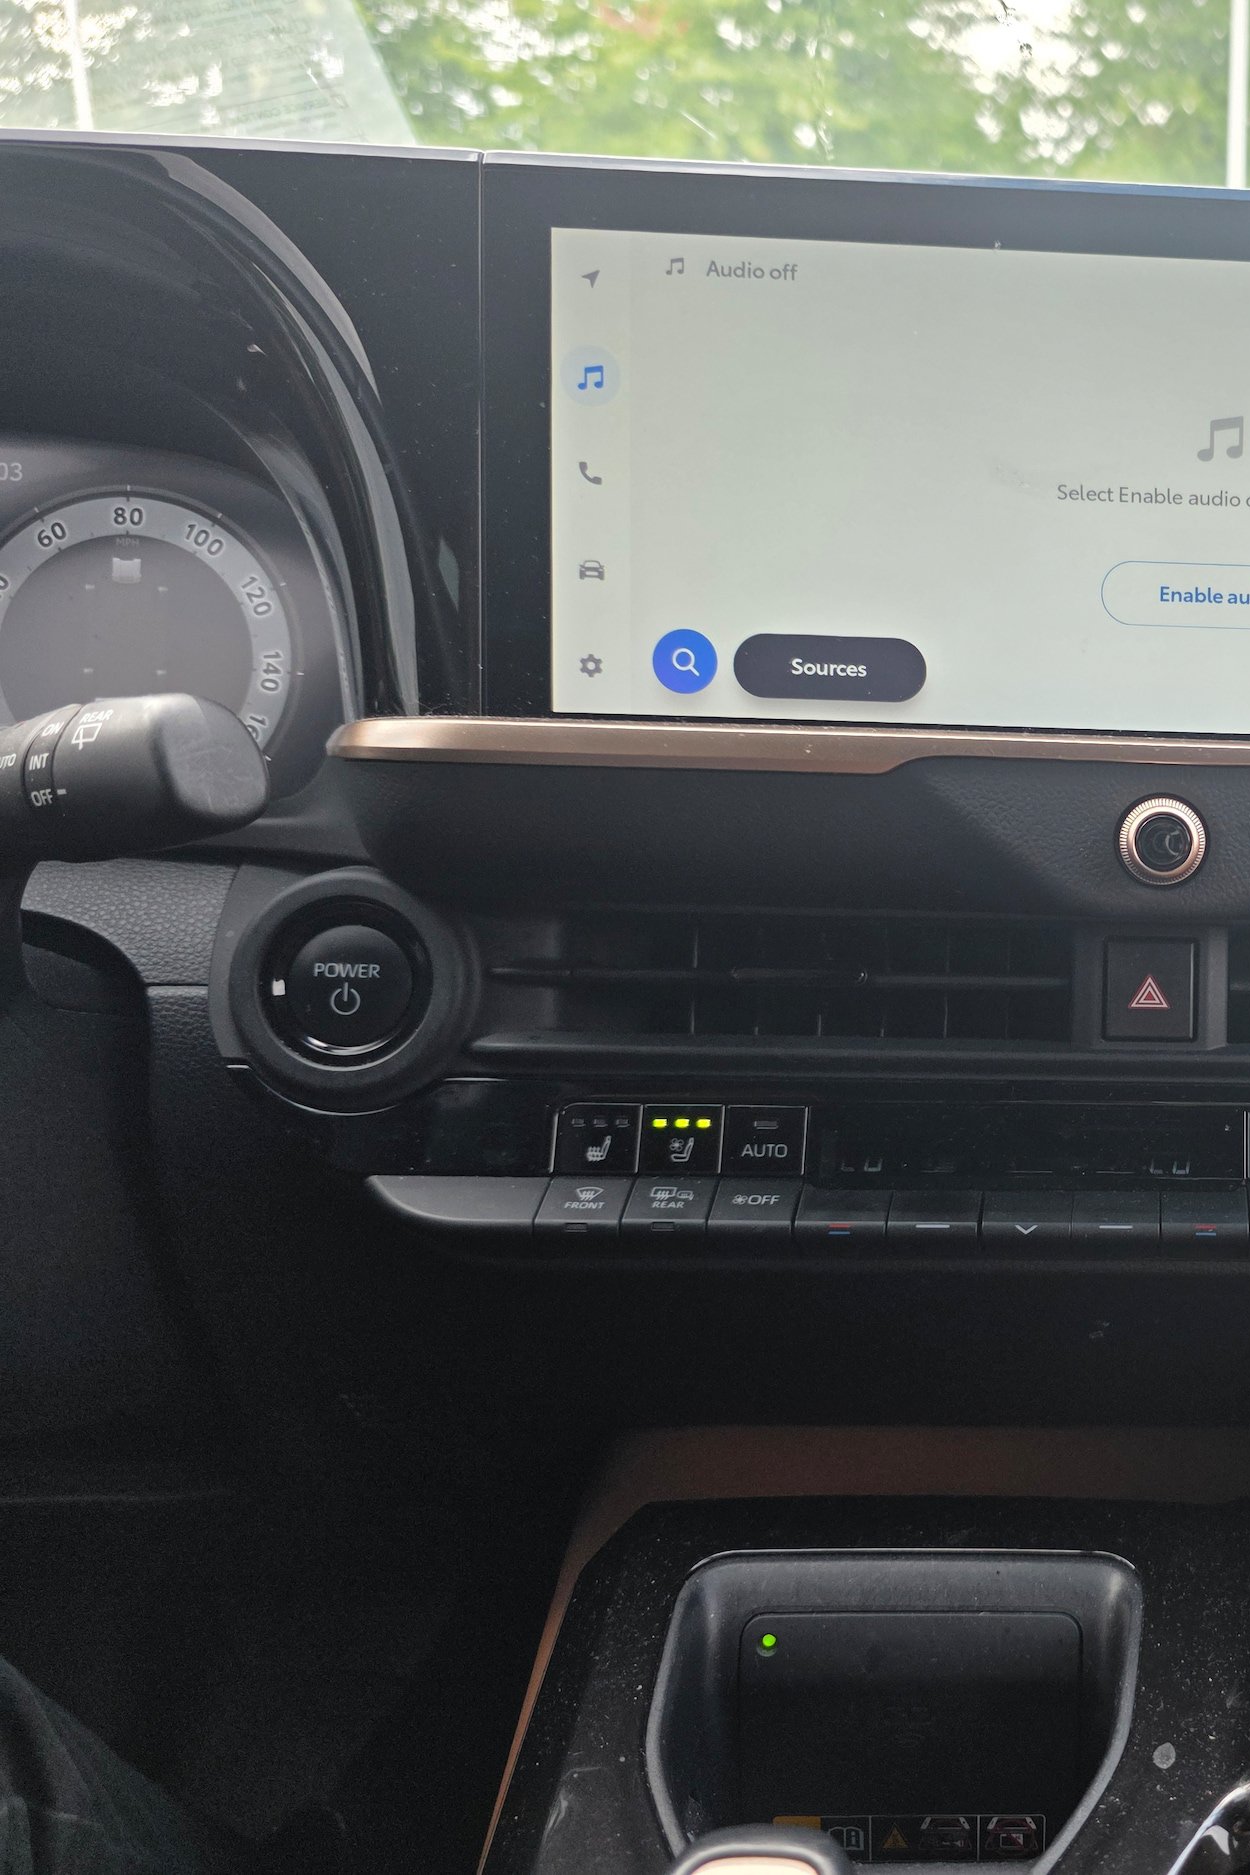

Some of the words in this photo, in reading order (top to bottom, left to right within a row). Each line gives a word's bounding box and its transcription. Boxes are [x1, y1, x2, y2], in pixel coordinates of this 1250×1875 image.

[706, 260, 765, 279] Audio
[769, 264, 798, 281] off
[1057, 484, 1114, 502] Select
[1118, 486, 1184, 506] Enable
[1188, 490, 1241, 508] audio
[113, 506, 144, 527] 80
[37, 522, 67, 548] 60
[185, 523, 224, 556] 100
[241, 576, 272, 617] 120
[1159, 586, 1224, 604] Enable
[260, 651, 282, 692] 140
[791, 658, 867, 677] Sources
[80, 709, 114, 723] REAR
[41, 721, 65, 736] ON
[29, 752, 49, 770] INT
[30, 788, 53, 806] OFF
[313, 962, 381, 978] POWER
[741, 1143, 788, 1158] AUTO
[564, 1201, 605, 1209] FRONT
[652, 1200, 684, 1209] REAR
[747, 1194, 781, 1206] OFF
